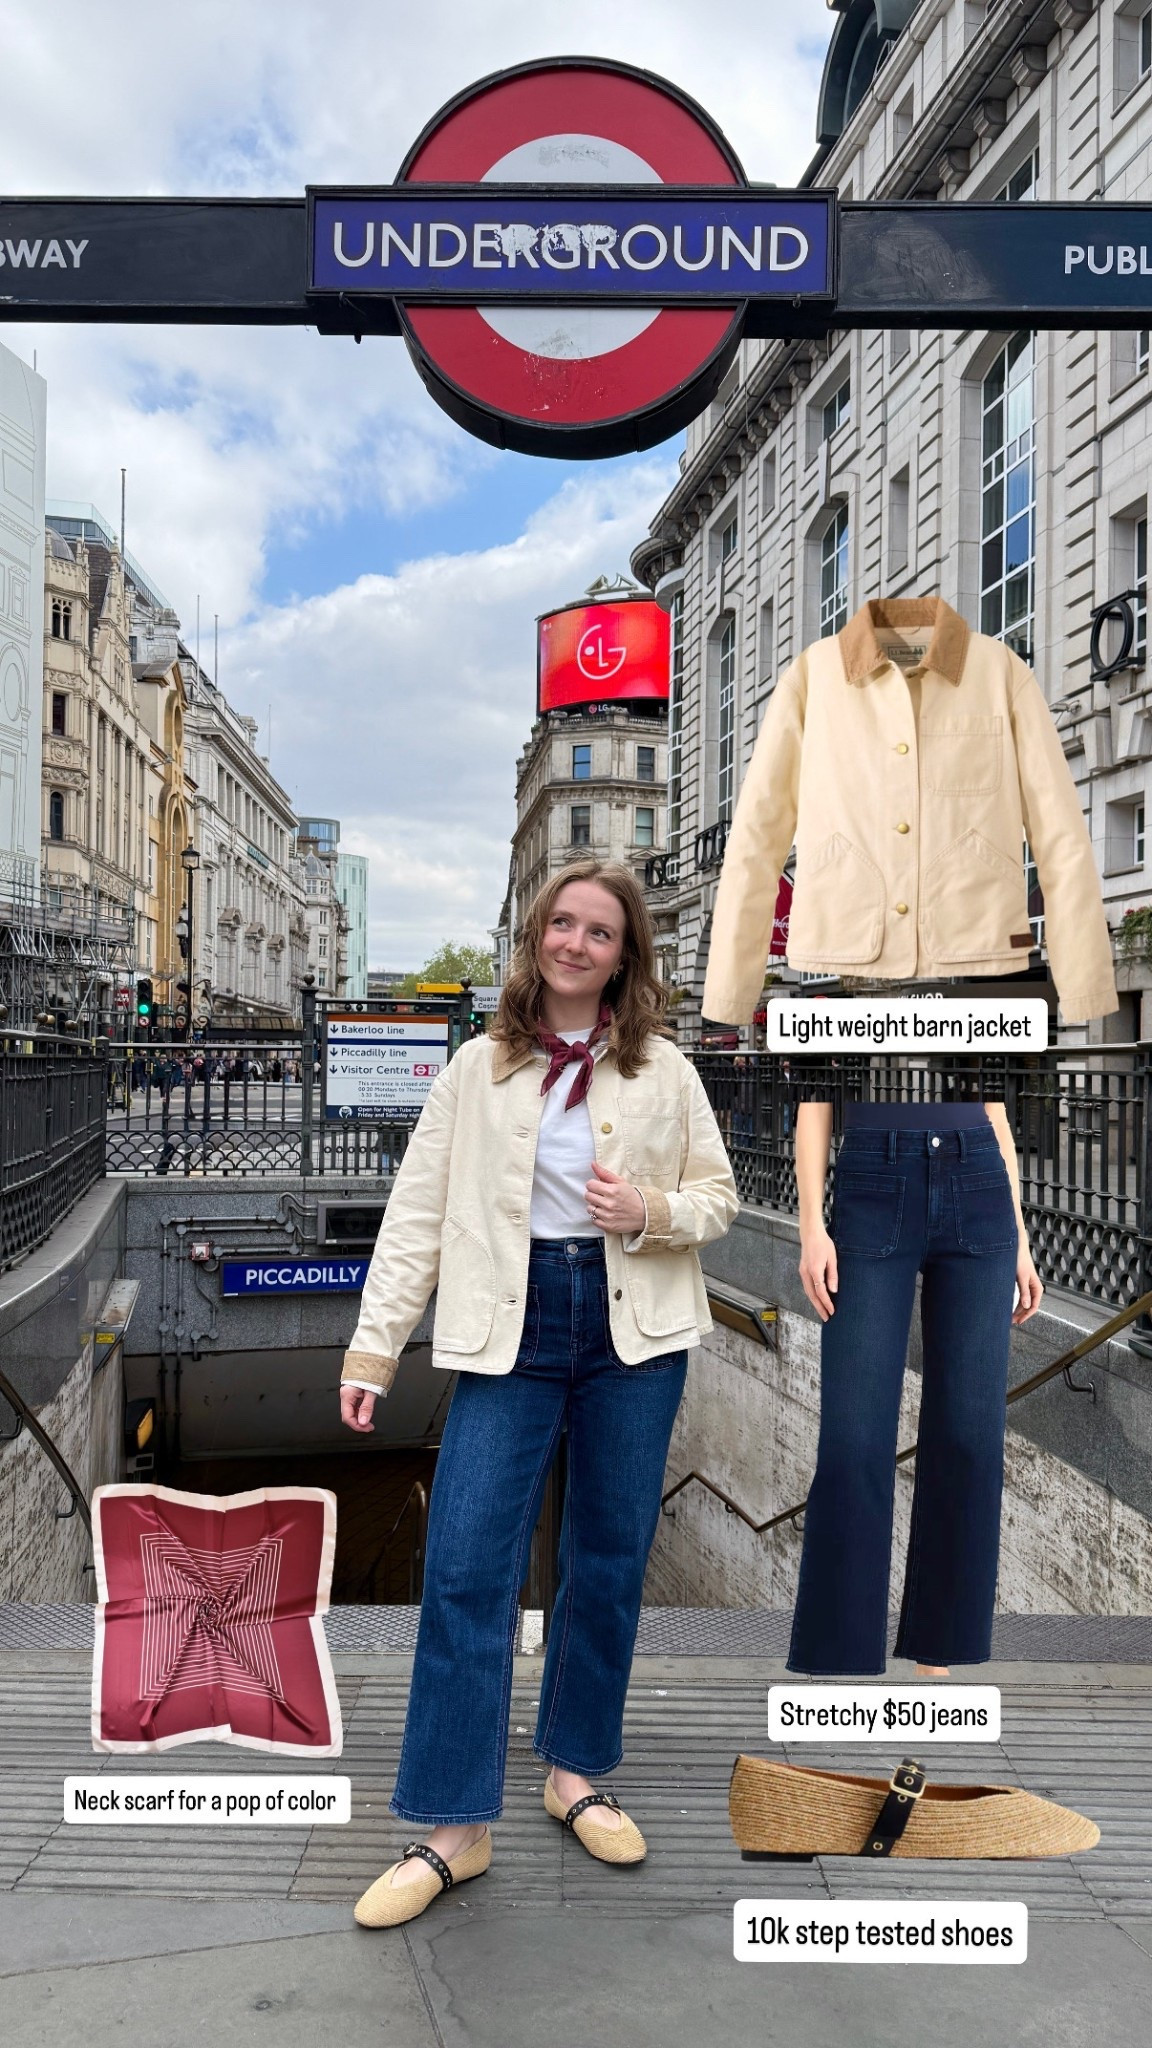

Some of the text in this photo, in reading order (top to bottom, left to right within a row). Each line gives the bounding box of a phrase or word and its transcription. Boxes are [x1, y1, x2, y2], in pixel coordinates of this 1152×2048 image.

[333, 221, 809, 272] UNDERGROUND
[1065, 245, 1152, 275] PUBL
[473, 995, 498, 1003] Square
[341, 1025, 405, 1035] Bakerloo line
[341, 1048, 407, 1059] Piccadilly line
[341, 1065, 373, 1074] Visitor
[376, 1066, 410, 1075] Centre
[246, 1266, 361, 1286] PICCADILLY
